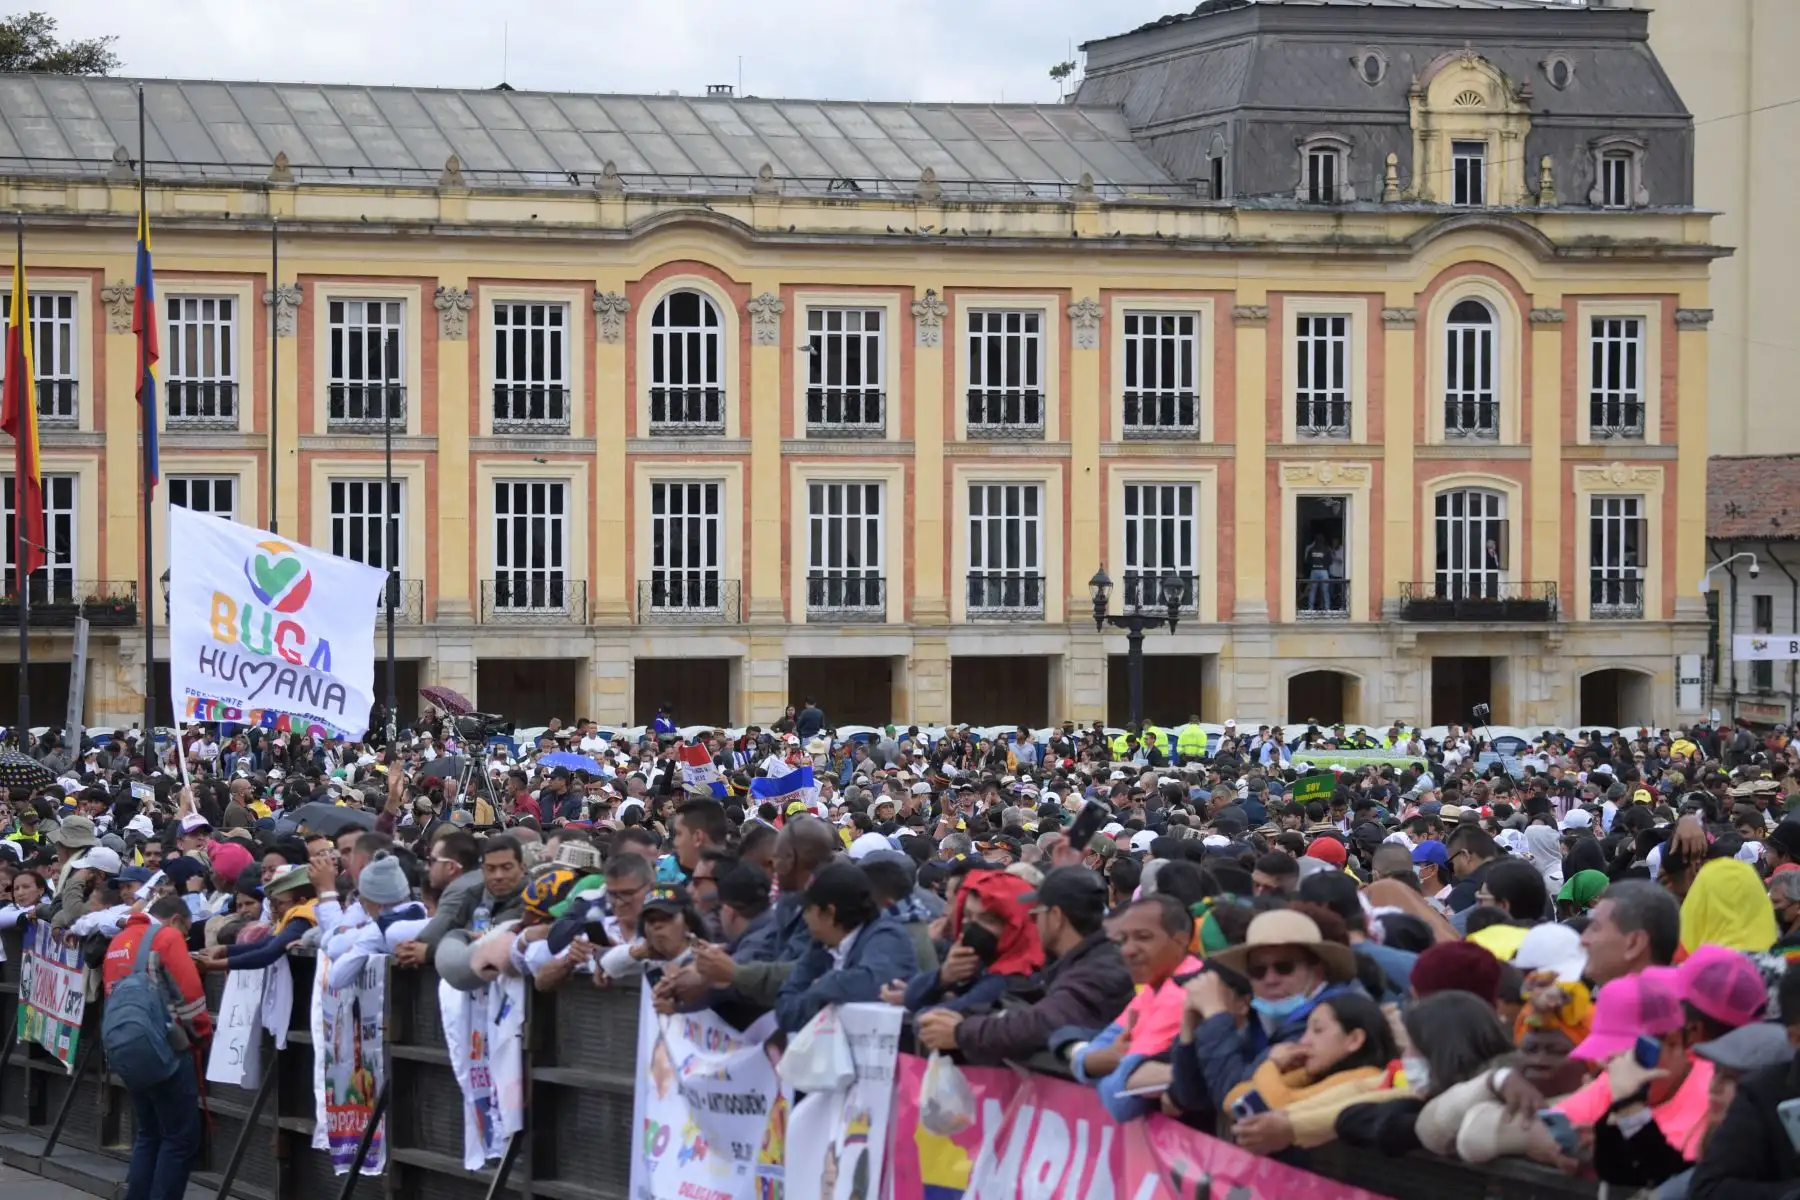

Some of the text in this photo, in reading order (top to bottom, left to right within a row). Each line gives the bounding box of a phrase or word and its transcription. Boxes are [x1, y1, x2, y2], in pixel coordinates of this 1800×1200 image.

[211, 590, 331, 673] BUGA
[1789, 640, 1800, 654] B
[199, 645, 346, 715] HUMANA
[185, 696, 242, 721] PETRO
